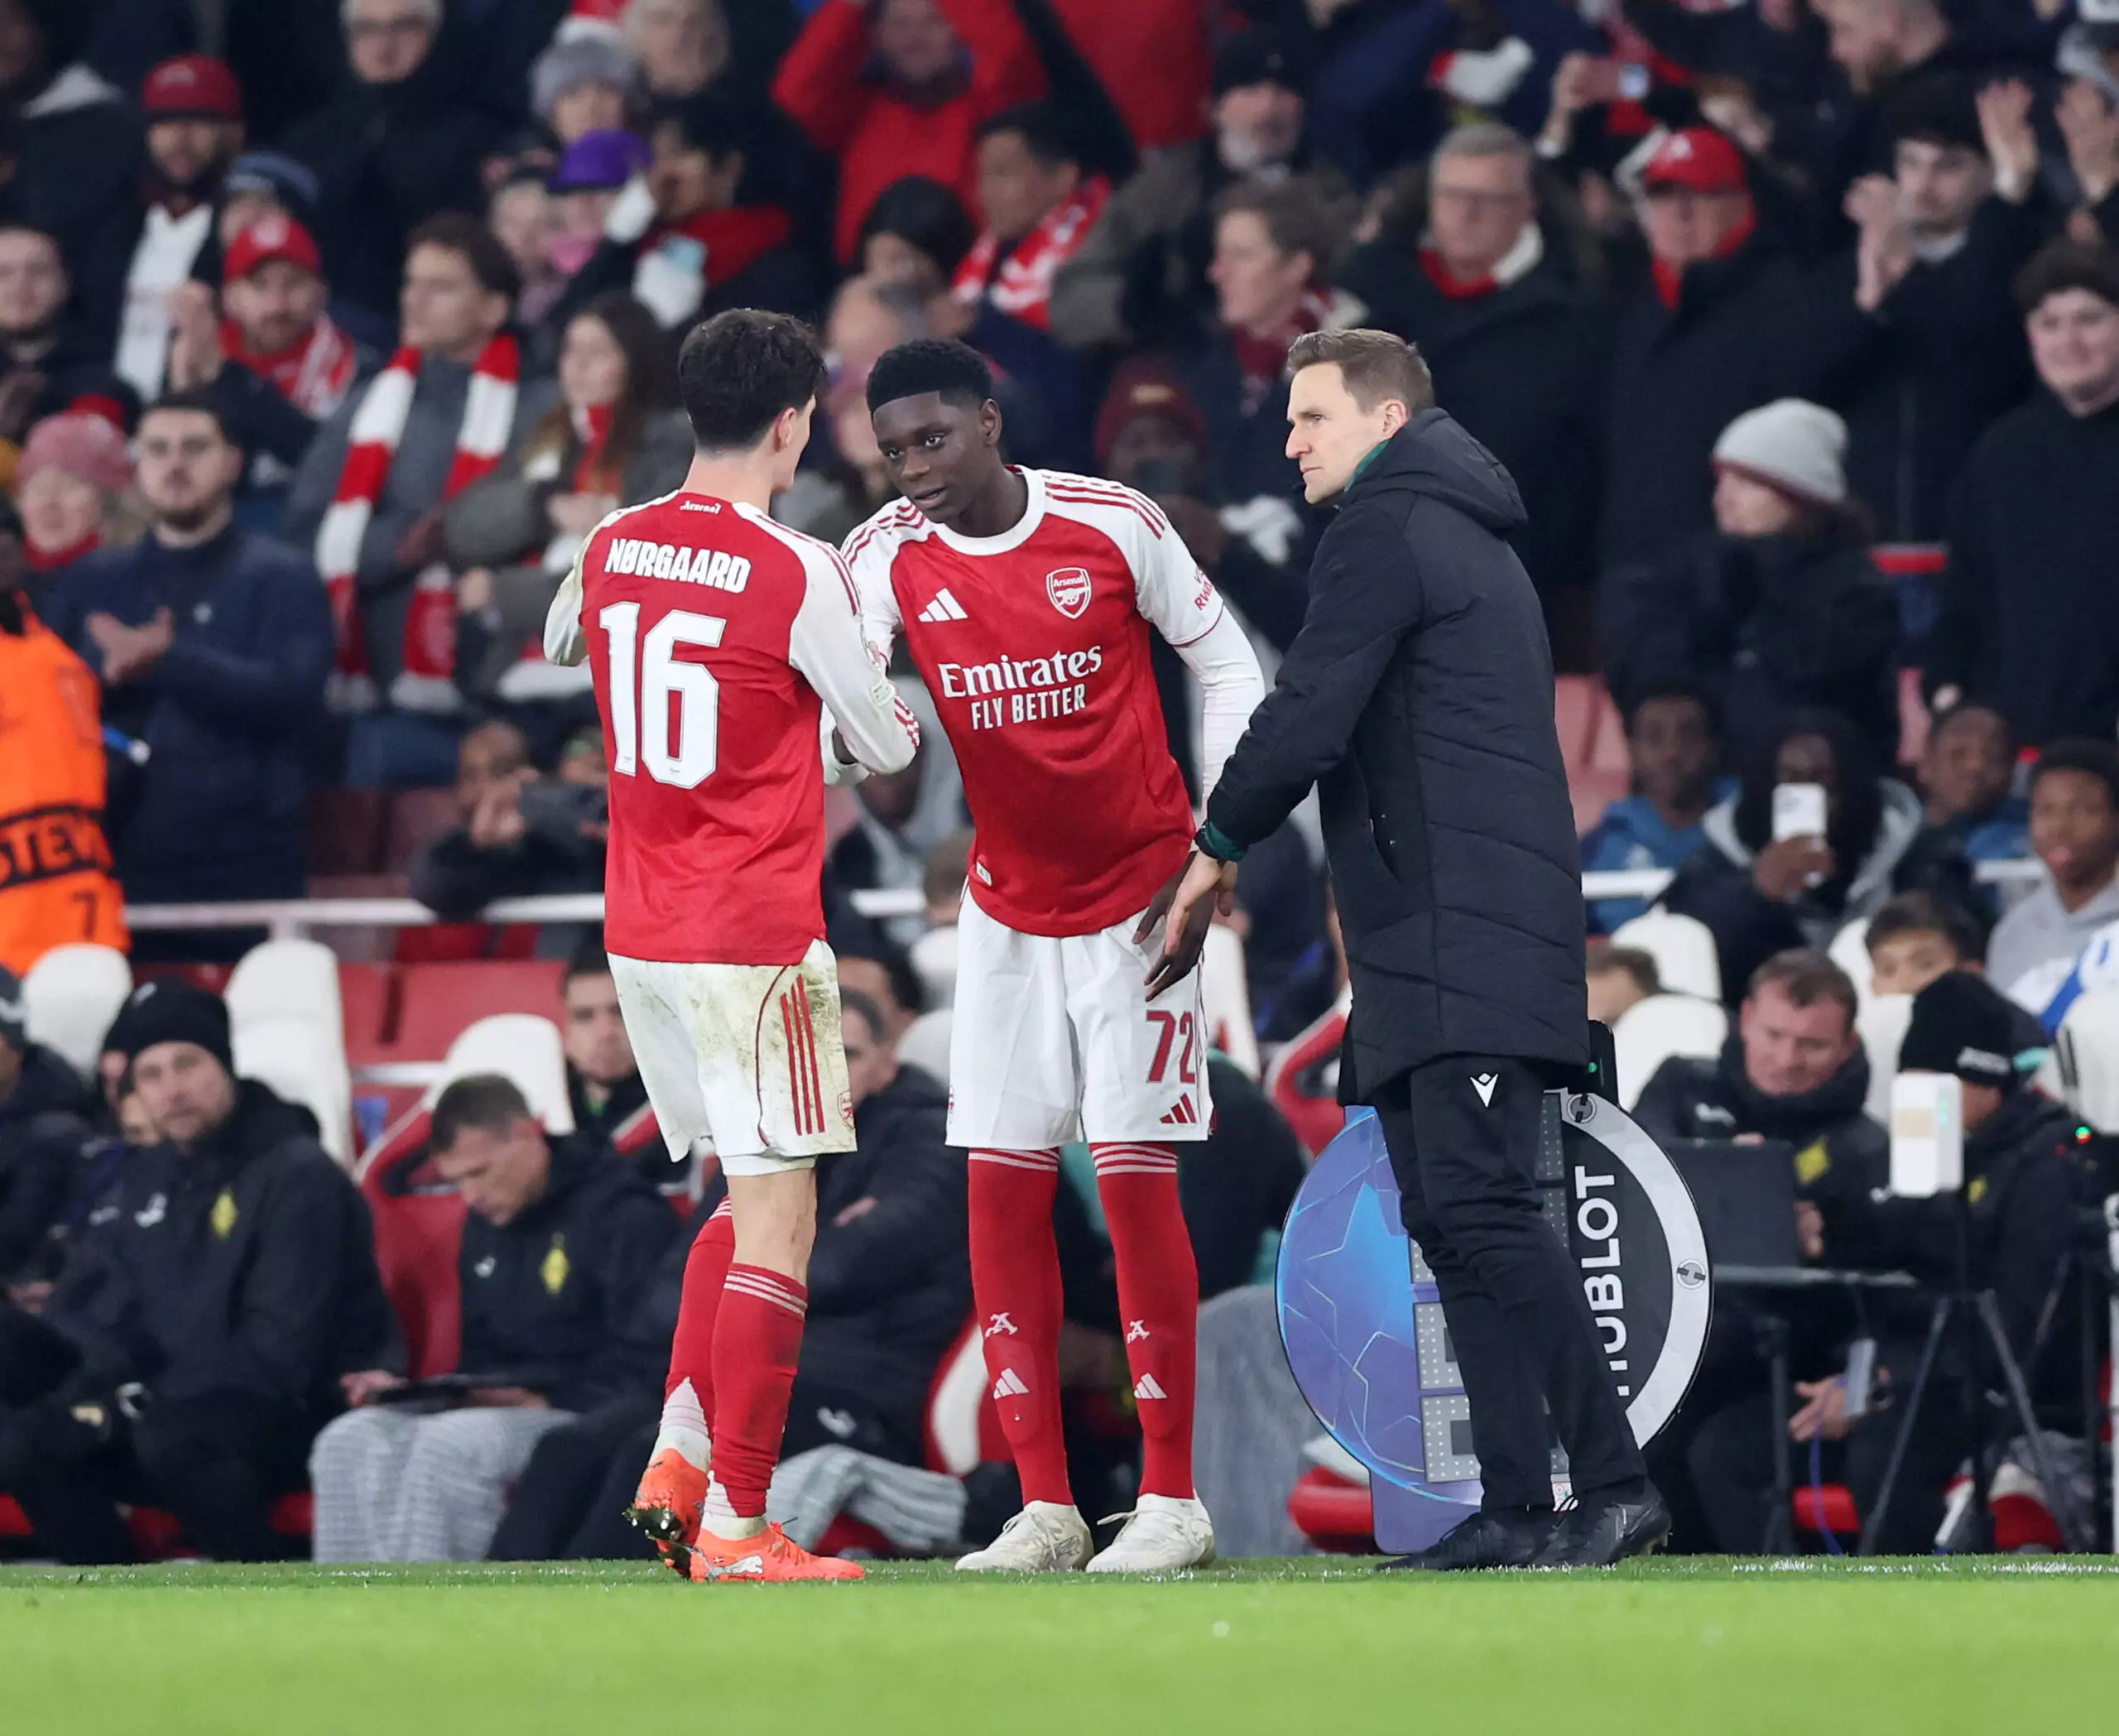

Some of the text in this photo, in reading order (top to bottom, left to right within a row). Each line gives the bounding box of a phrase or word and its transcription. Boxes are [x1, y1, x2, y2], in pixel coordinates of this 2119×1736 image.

[680, 499, 722, 515] Arsenal
[604, 538, 752, 594] NØRGAARD
[1054, 575, 1085, 588] Arsenal
[598, 601, 727, 790] 16
[938, 646, 1103, 698] Emirates
[971, 683, 1086, 730] FLY BETTER
[72, 890, 99, 940] 7
[1146, 1010, 1196, 1084] 72
